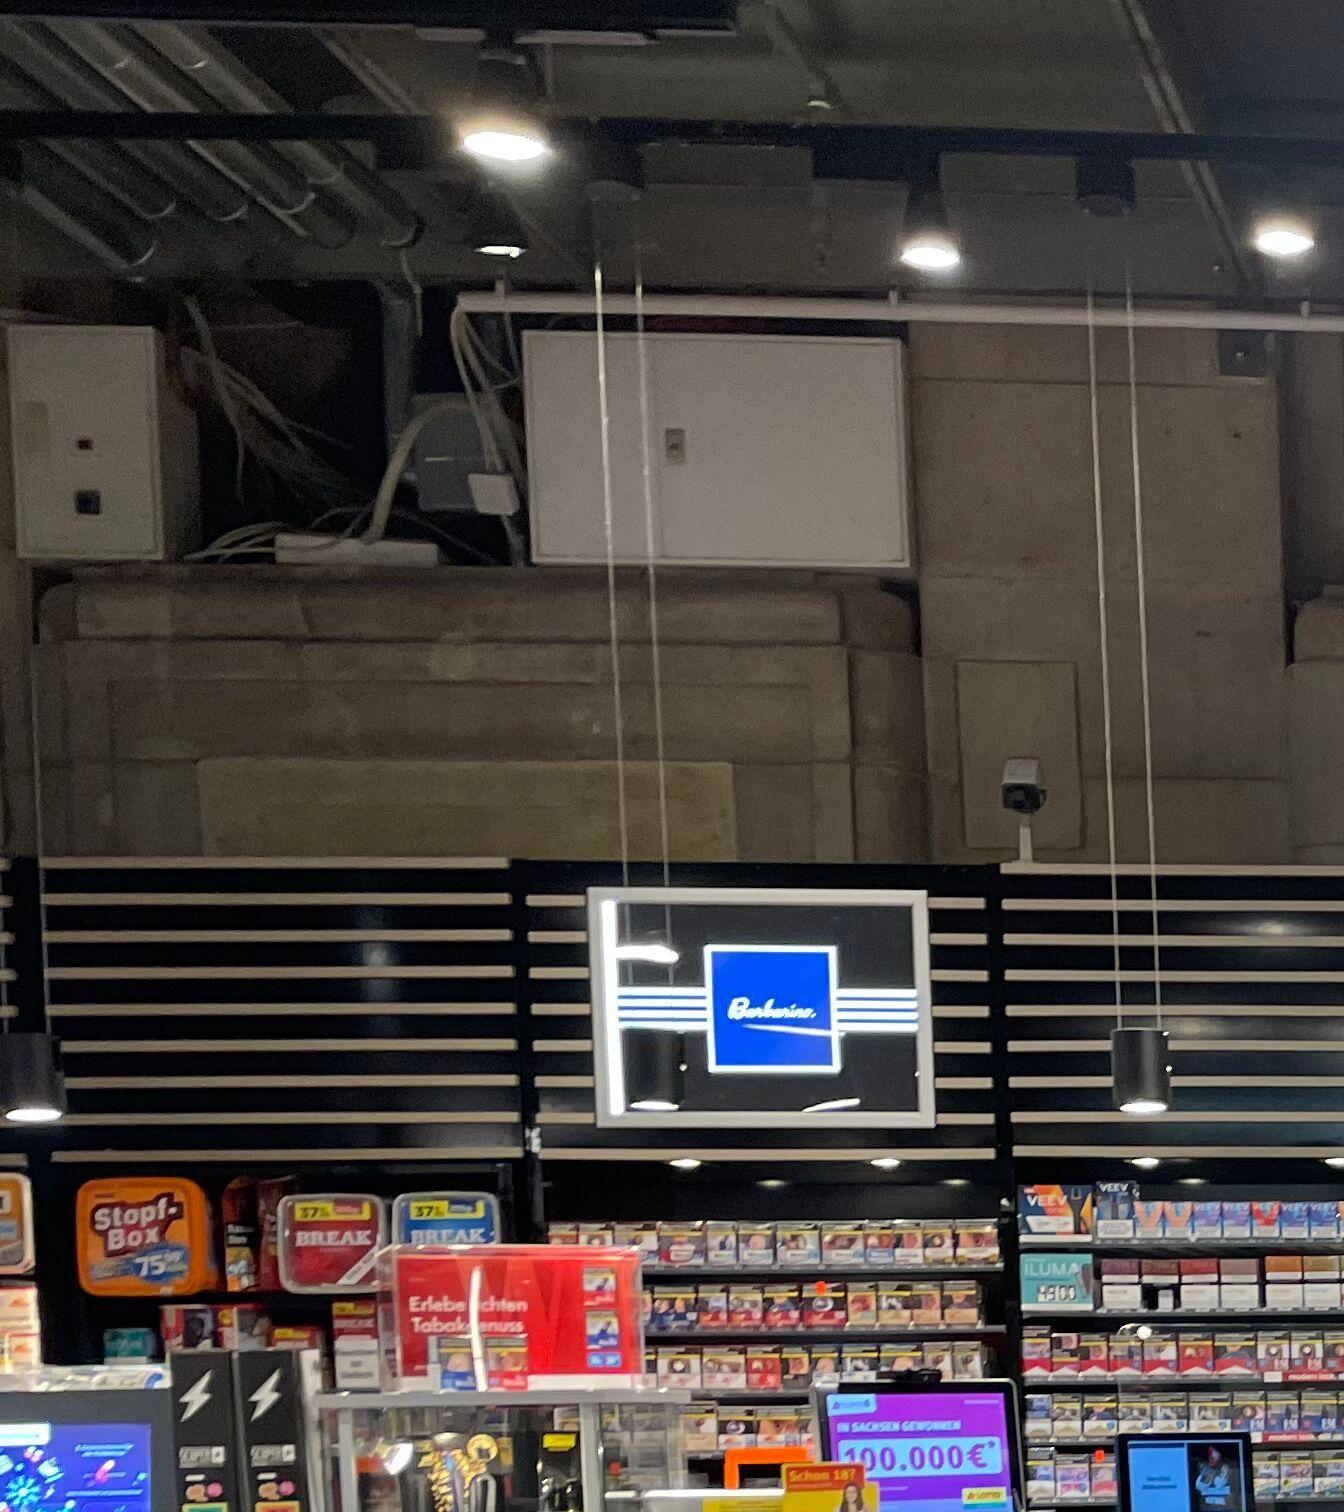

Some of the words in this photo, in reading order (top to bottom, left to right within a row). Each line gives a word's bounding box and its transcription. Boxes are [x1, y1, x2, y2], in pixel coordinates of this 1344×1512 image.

[1026, 1195, 1068, 1207] VEEV
[94, 1197, 178, 1231] Stopf-
[107, 1226, 163, 1251] Box
[296, 1230, 373, 1247] BREAK
[411, 1228, 487, 1244] BREAK
[408, 1296, 466, 1314] Erlebe
[481, 1295, 529, 1314] chten
[410, 1314, 525, 1334] Tabakenuss
[789, 1470, 830, 1482] Schon
